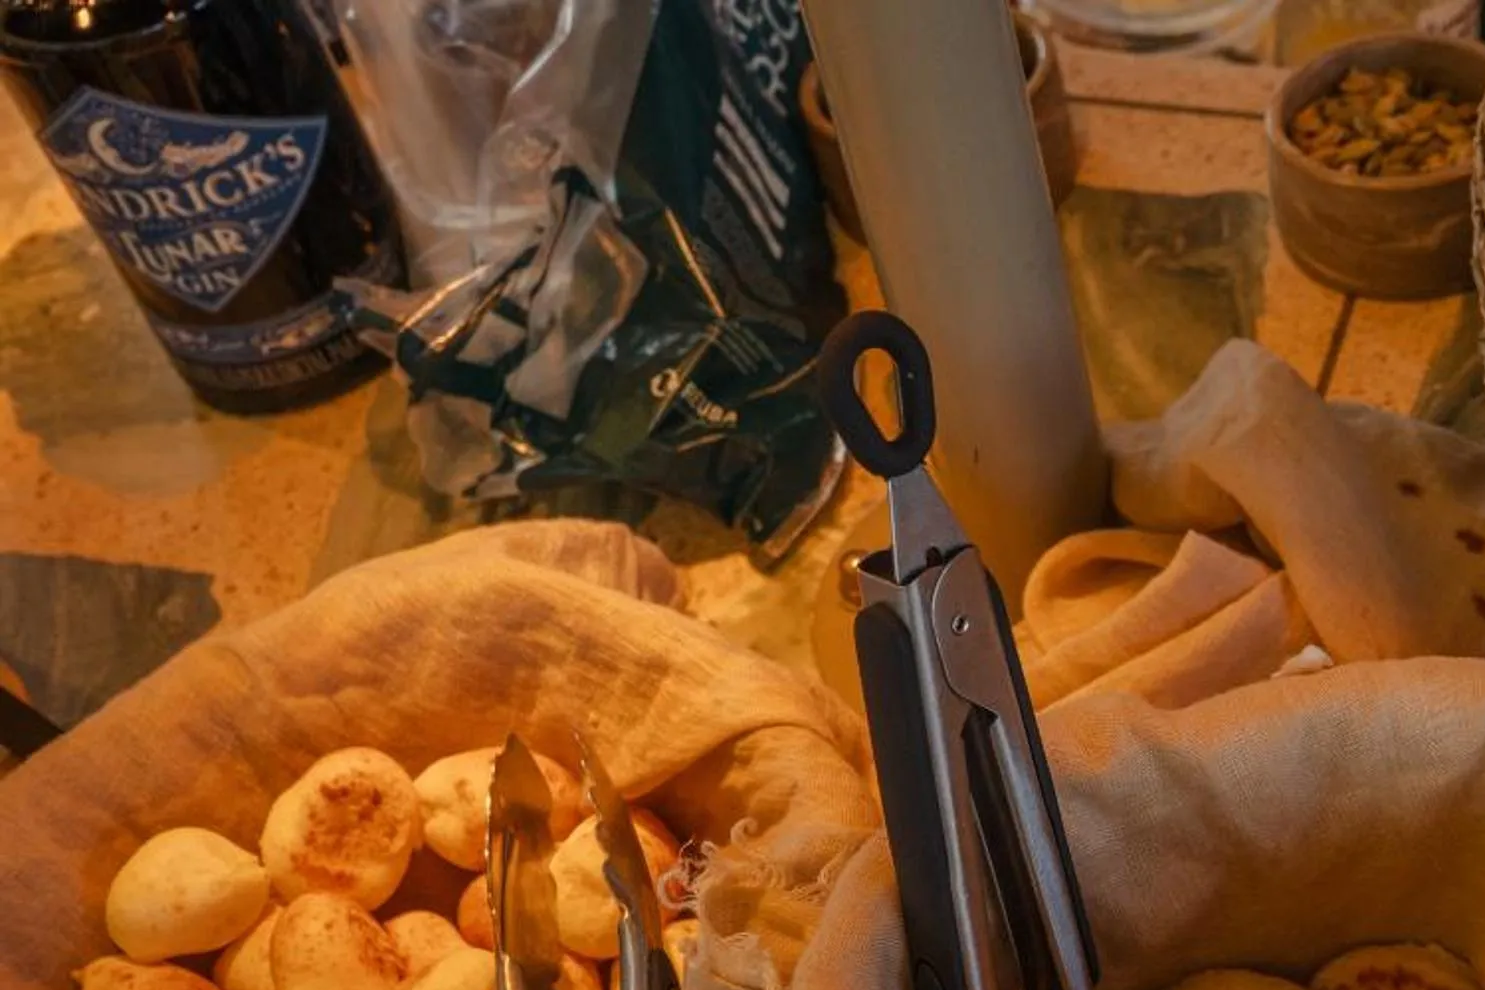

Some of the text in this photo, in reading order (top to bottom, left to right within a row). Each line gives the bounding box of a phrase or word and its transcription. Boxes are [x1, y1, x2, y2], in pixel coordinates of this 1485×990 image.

[80, 134, 306, 220] NDRICK'S
[119, 226, 251, 284] LUNAR
[175, 266, 245, 295] GIN
